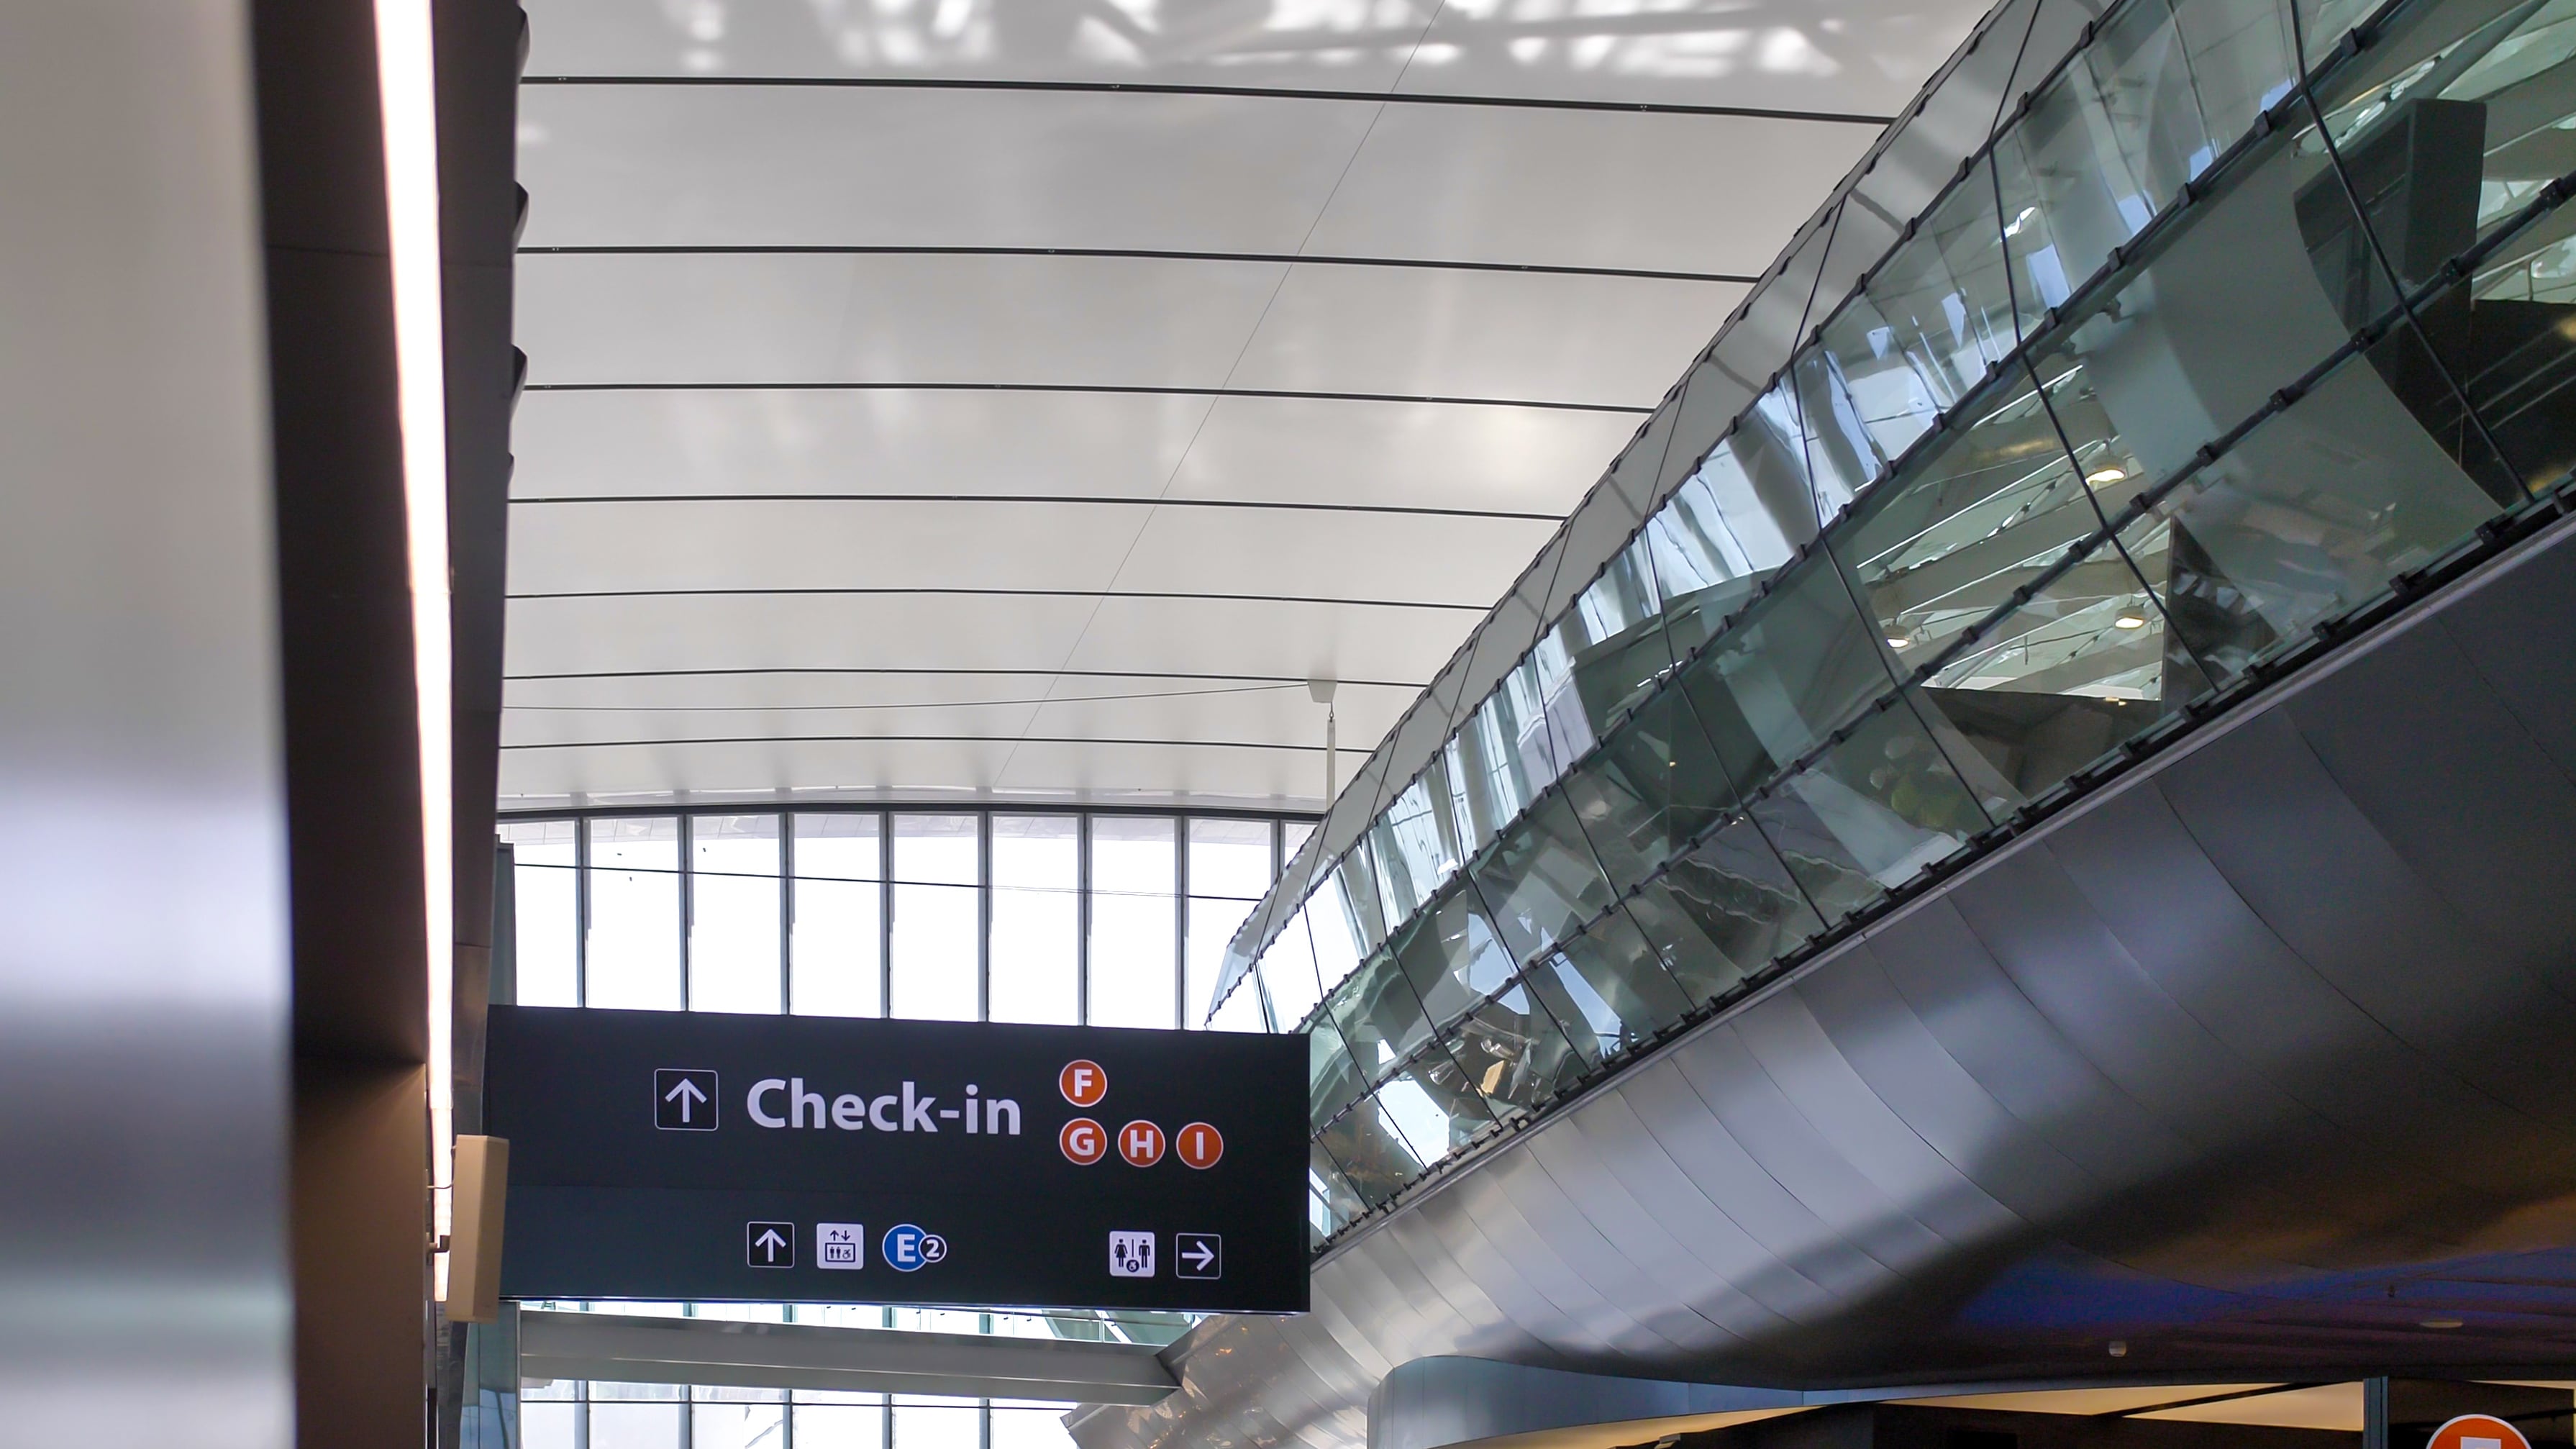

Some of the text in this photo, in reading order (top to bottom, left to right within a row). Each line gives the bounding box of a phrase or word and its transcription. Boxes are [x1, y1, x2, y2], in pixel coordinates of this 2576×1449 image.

[1075, 1069, 1092, 1097] F
[747, 1078, 1021, 1135] Check-in
[1070, 1127, 1094, 1155] G
[1130, 1130, 1153, 1158] H
[897, 1234, 939, 1262] E 2
